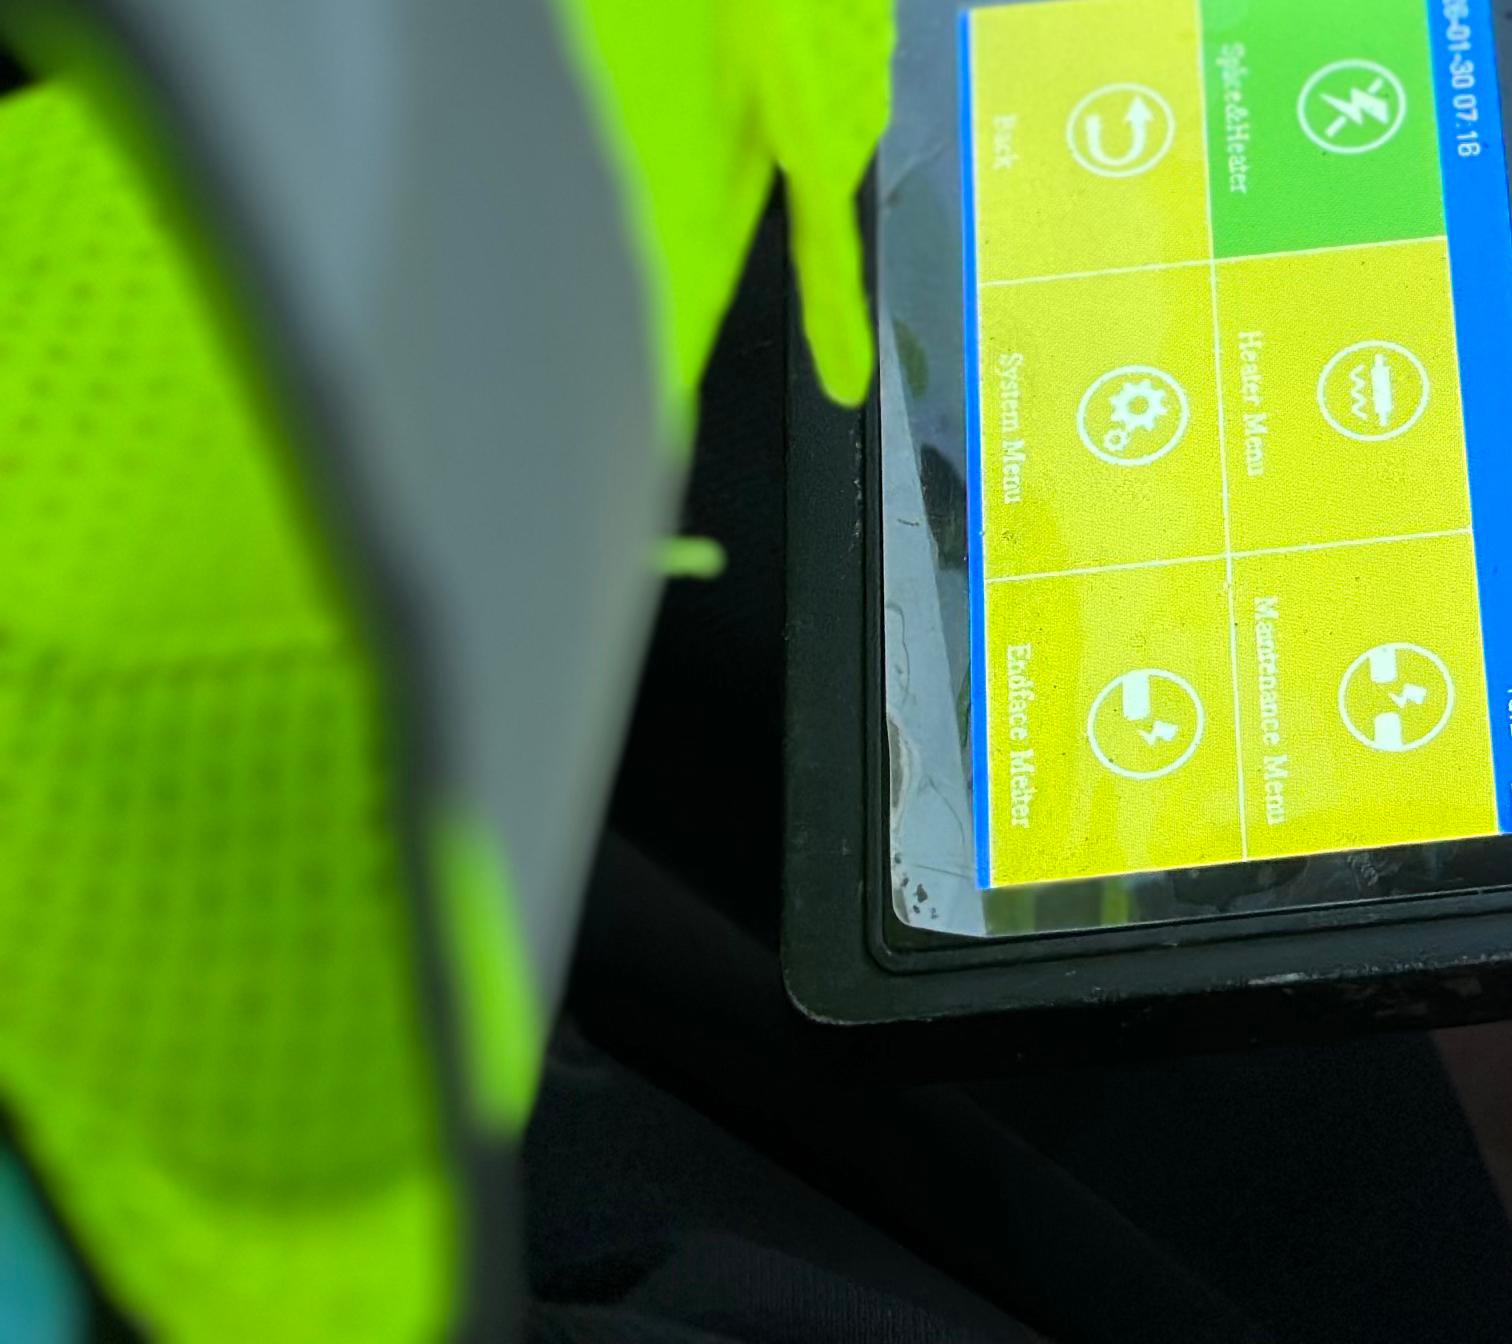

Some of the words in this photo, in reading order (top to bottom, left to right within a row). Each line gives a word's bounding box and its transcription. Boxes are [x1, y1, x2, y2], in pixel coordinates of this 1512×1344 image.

[996, 352, 1028, 431] System
[1238, 330, 1264, 404] Heater
[1002, 437, 1027, 504] Menu
[1241, 408, 1269, 477] Menu
[1006, 644, 1033, 741] Endface
[1252, 596, 1283, 745] Maintenance
[1263, 754, 1289, 826] Menu
